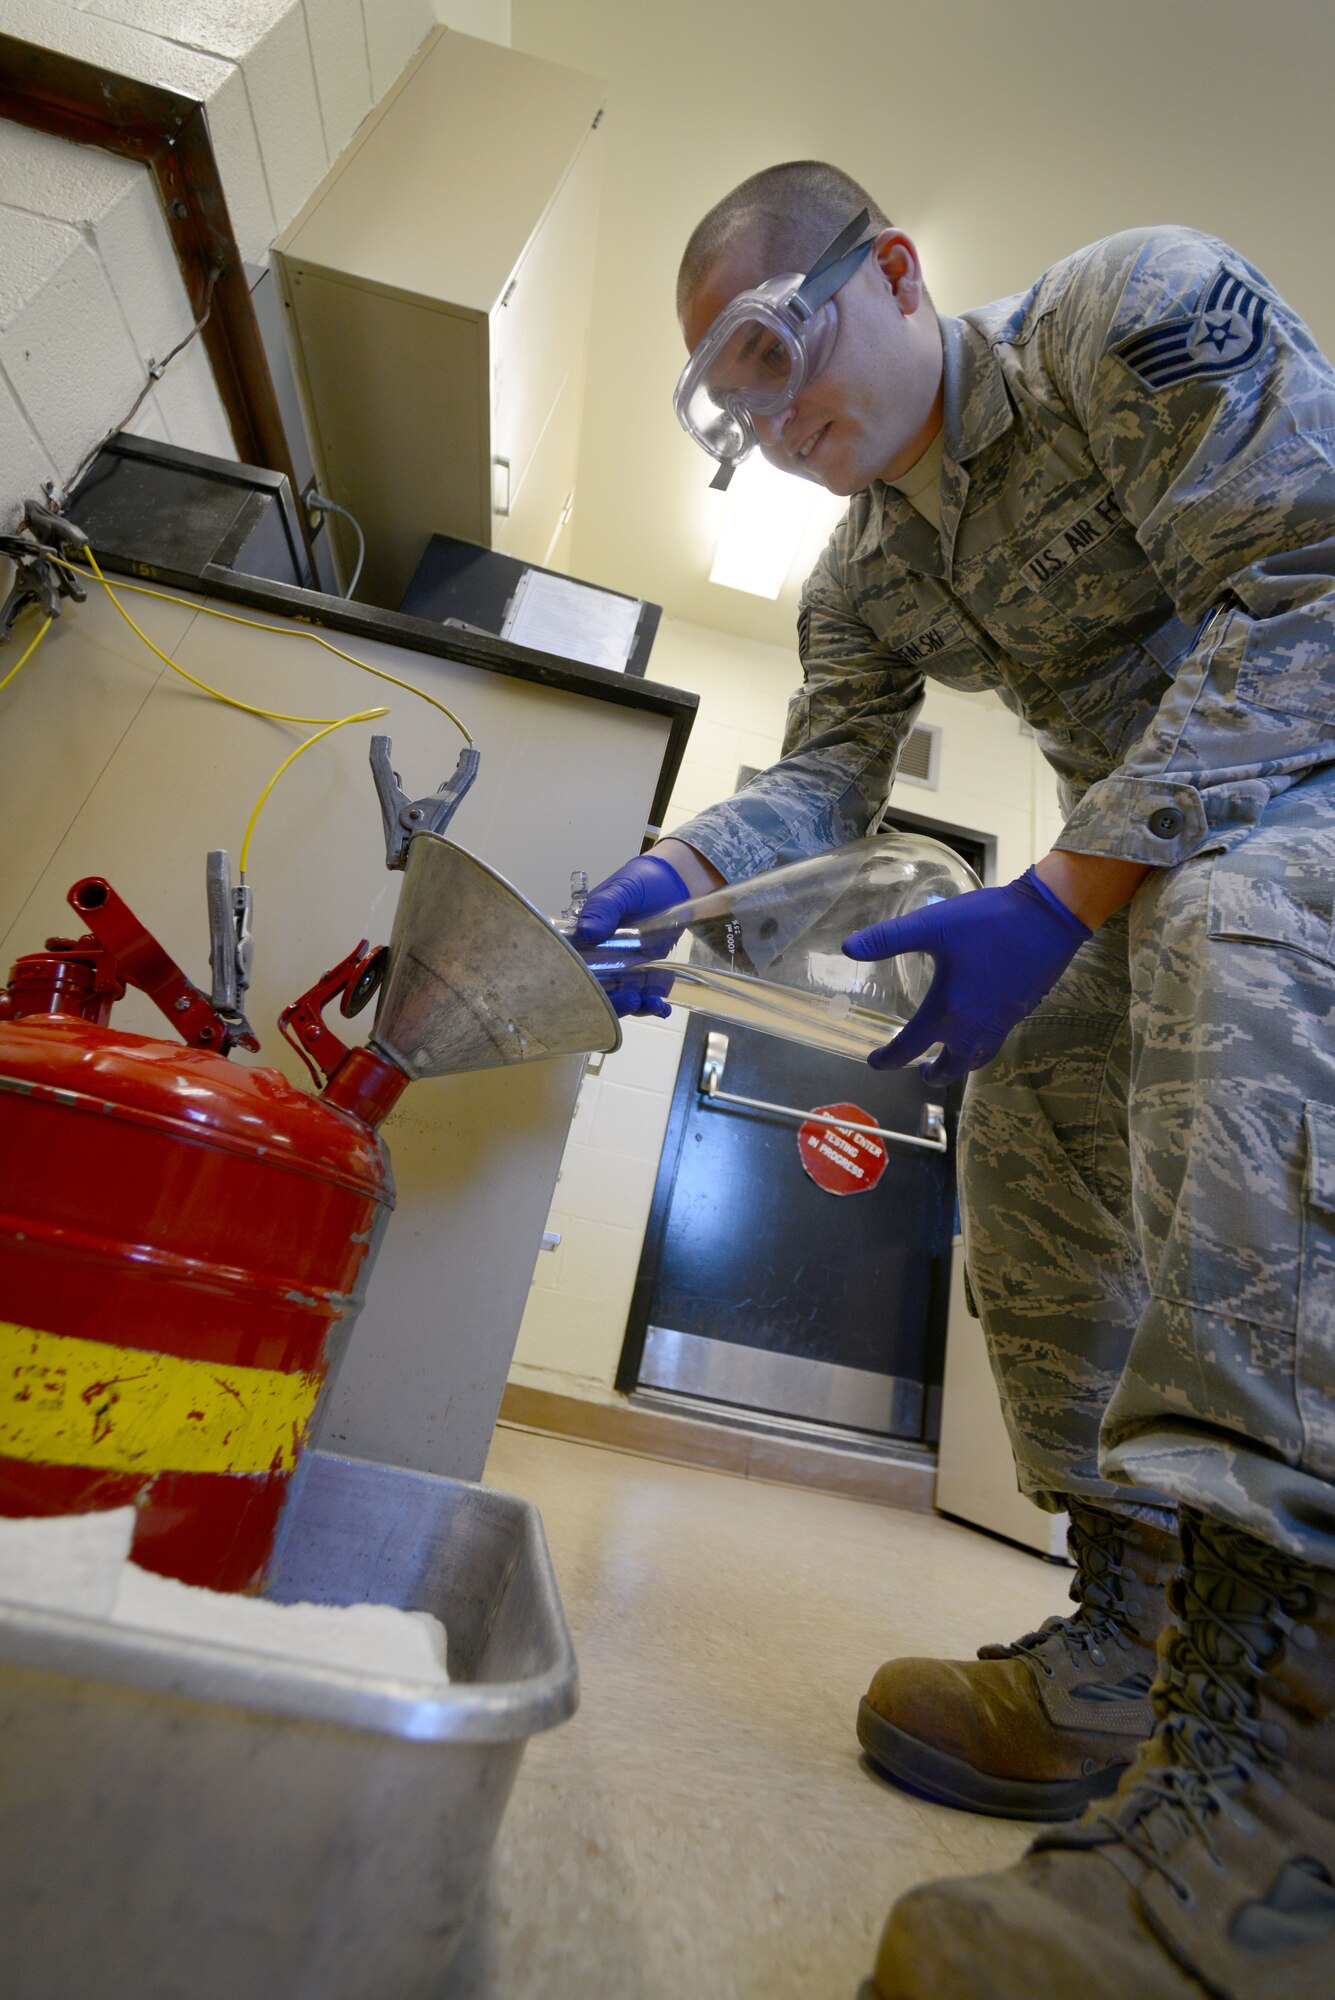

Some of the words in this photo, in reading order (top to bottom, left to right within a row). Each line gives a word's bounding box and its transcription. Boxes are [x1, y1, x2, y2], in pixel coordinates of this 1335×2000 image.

[1029, 549, 1067, 581] U.S.
[1064, 519, 1102, 555] AIR
[726, 933, 736, 954] 4000
[807, 1135, 820, 1149] IN
[818, 1143, 865, 1179] PROGRESS
[824, 1129, 860, 1158] TESTING
[853, 1133, 883, 1158] ENTER
